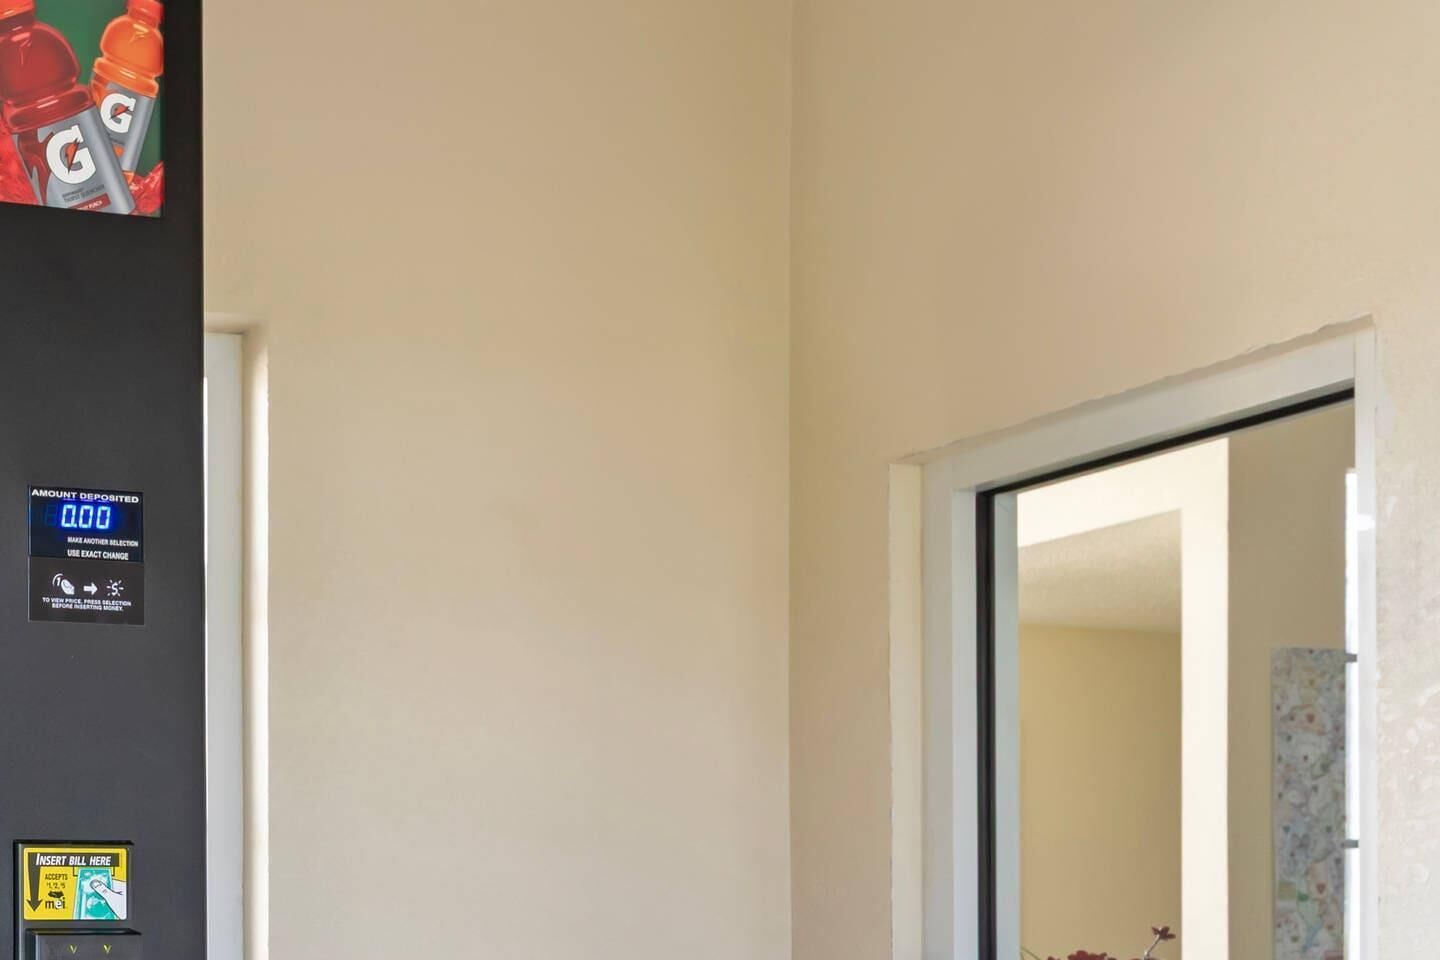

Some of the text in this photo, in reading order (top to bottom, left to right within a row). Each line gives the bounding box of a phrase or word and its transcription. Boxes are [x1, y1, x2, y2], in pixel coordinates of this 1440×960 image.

[100, 92, 137, 134] G
[46, 124, 97, 185] G
[32, 488, 139, 503] AMOUNT DEPOSITED
[61, 504, 111, 529] 0.00
[67, 536, 139, 547] MAKE ANOTHER SELECTION
[67, 549, 129, 560] USE EXACT CHANGE
[36, 852, 112, 866] INSERT BILL HERE
[45, 896, 66, 909] mei
